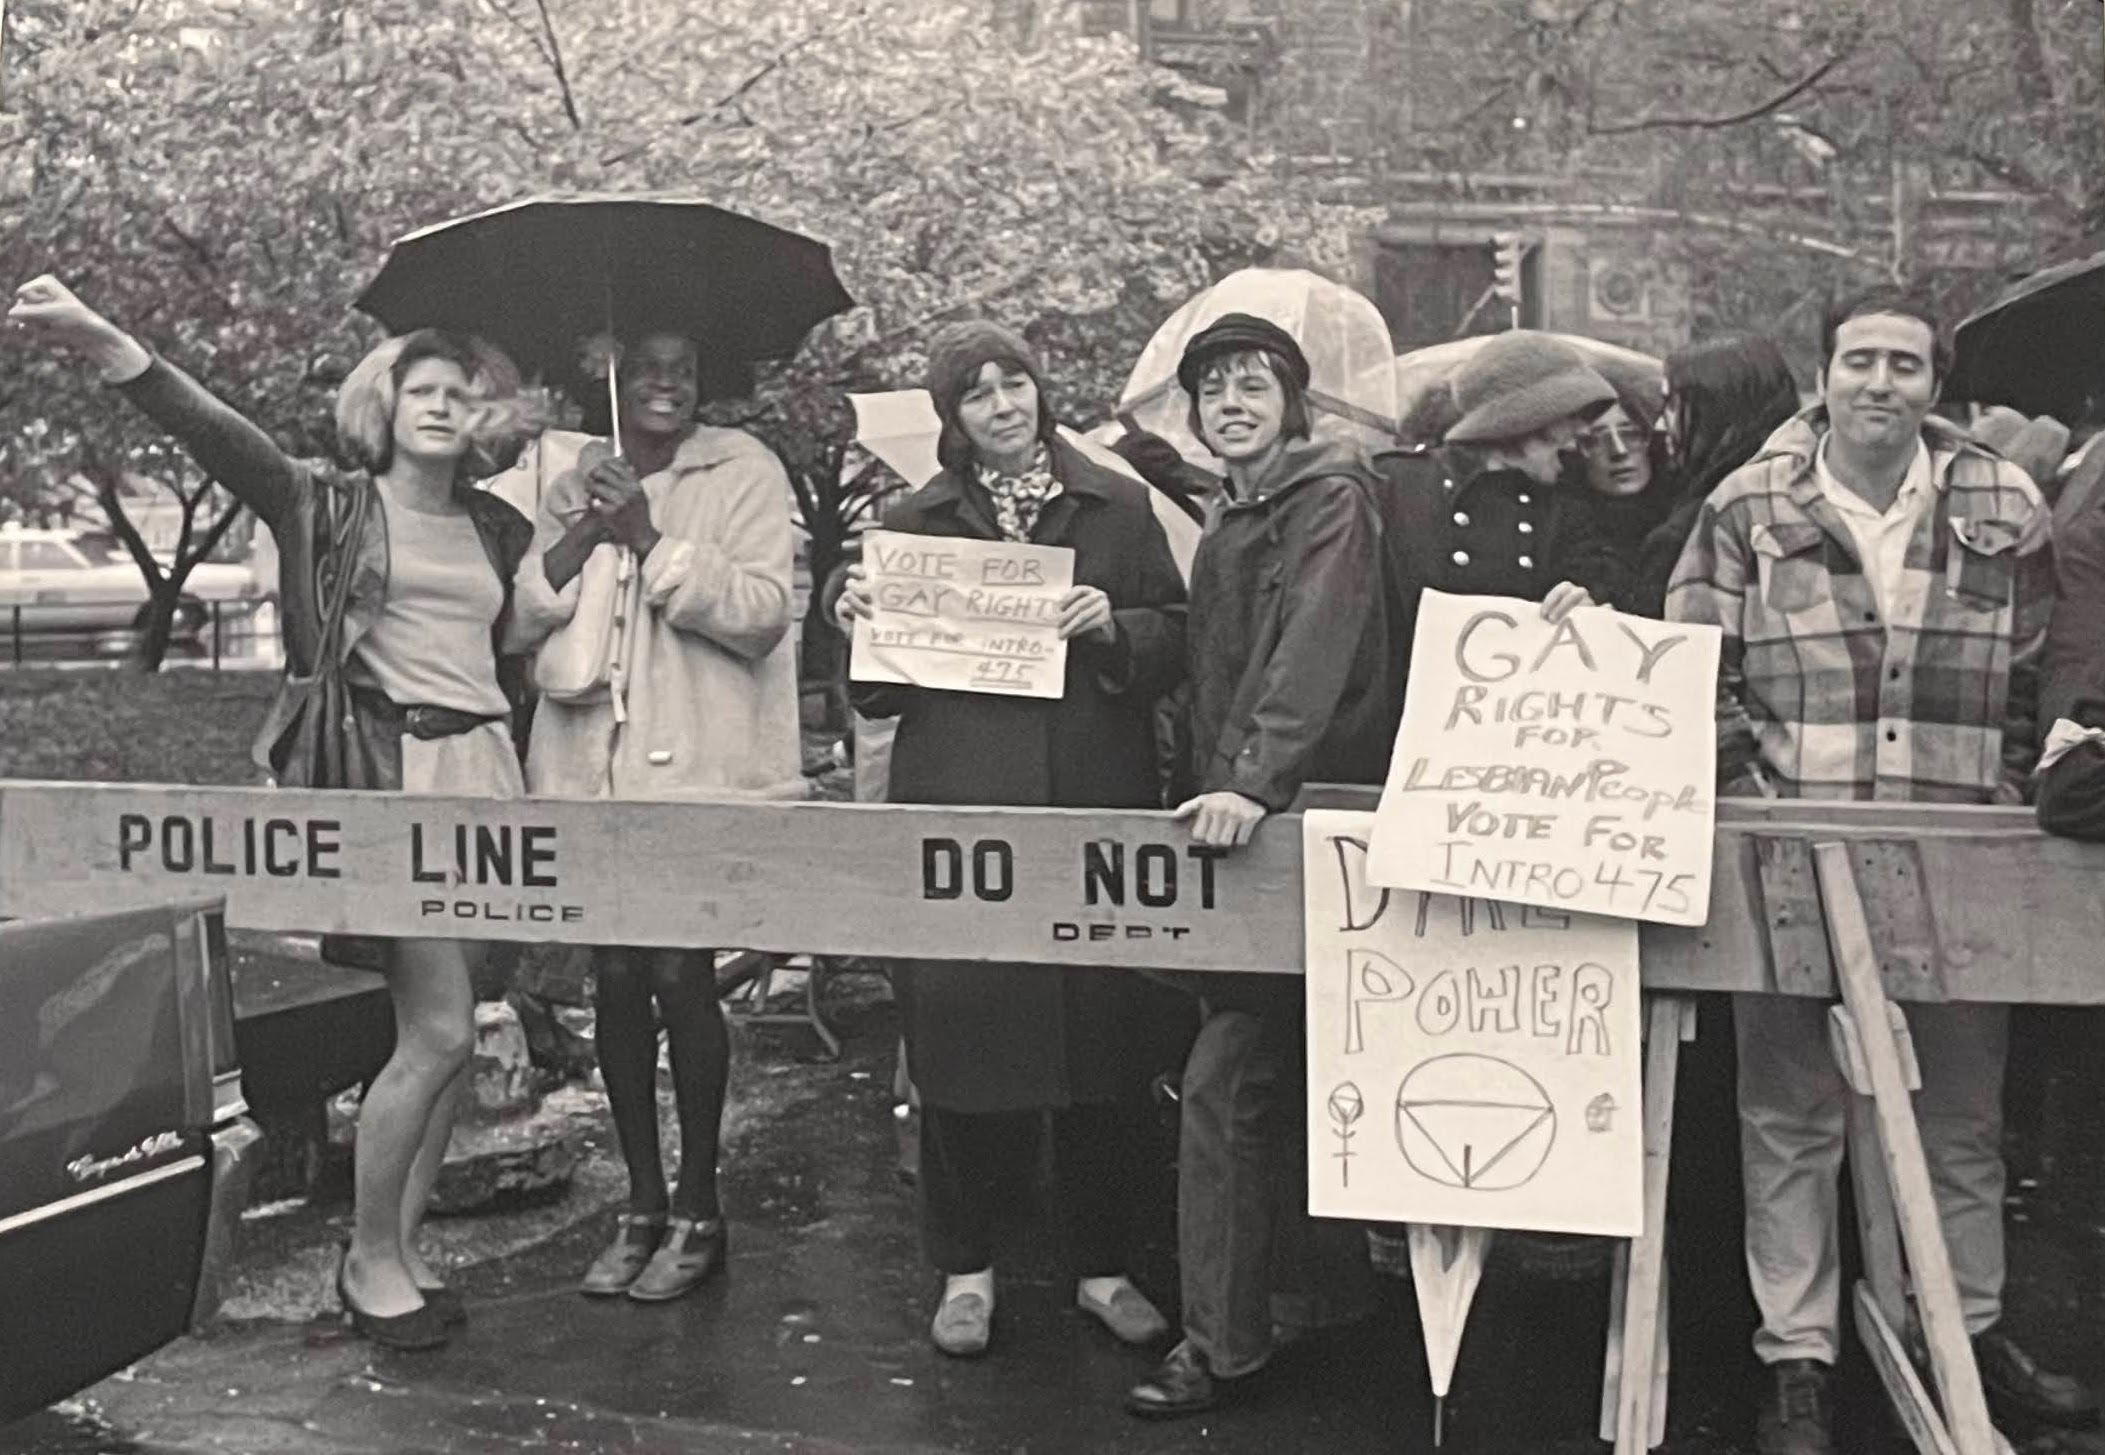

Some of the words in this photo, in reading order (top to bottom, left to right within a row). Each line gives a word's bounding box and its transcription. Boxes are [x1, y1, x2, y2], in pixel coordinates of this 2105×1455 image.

[875, 548, 955, 578] VOTE
[982, 558, 1043, 584] FOR
[878, 583, 946, 615] GAY
[977, 661, 1036, 680] 475
[1455, 610, 1687, 683] GAY
[1443, 684, 1672, 738] RIGHTS
[1513, 724, 1600, 751] FOR
[1402, 757, 1588, 800] LESBIAN
[119, 813, 341, 878] POLICE
[411, 821, 557, 887] LINE
[1446, 801, 1556, 839] VOTE
[1584, 815, 1667, 859] FOR
[922, 837, 1013, 902] DO
[1083, 839, 1228, 910] NOT
[1430, 840, 1583, 900] INTRO
[1594, 861, 1696, 914] 475
[420, 899, 585, 923] POLICE
[1345, 949, 1614, 1056] POWER
